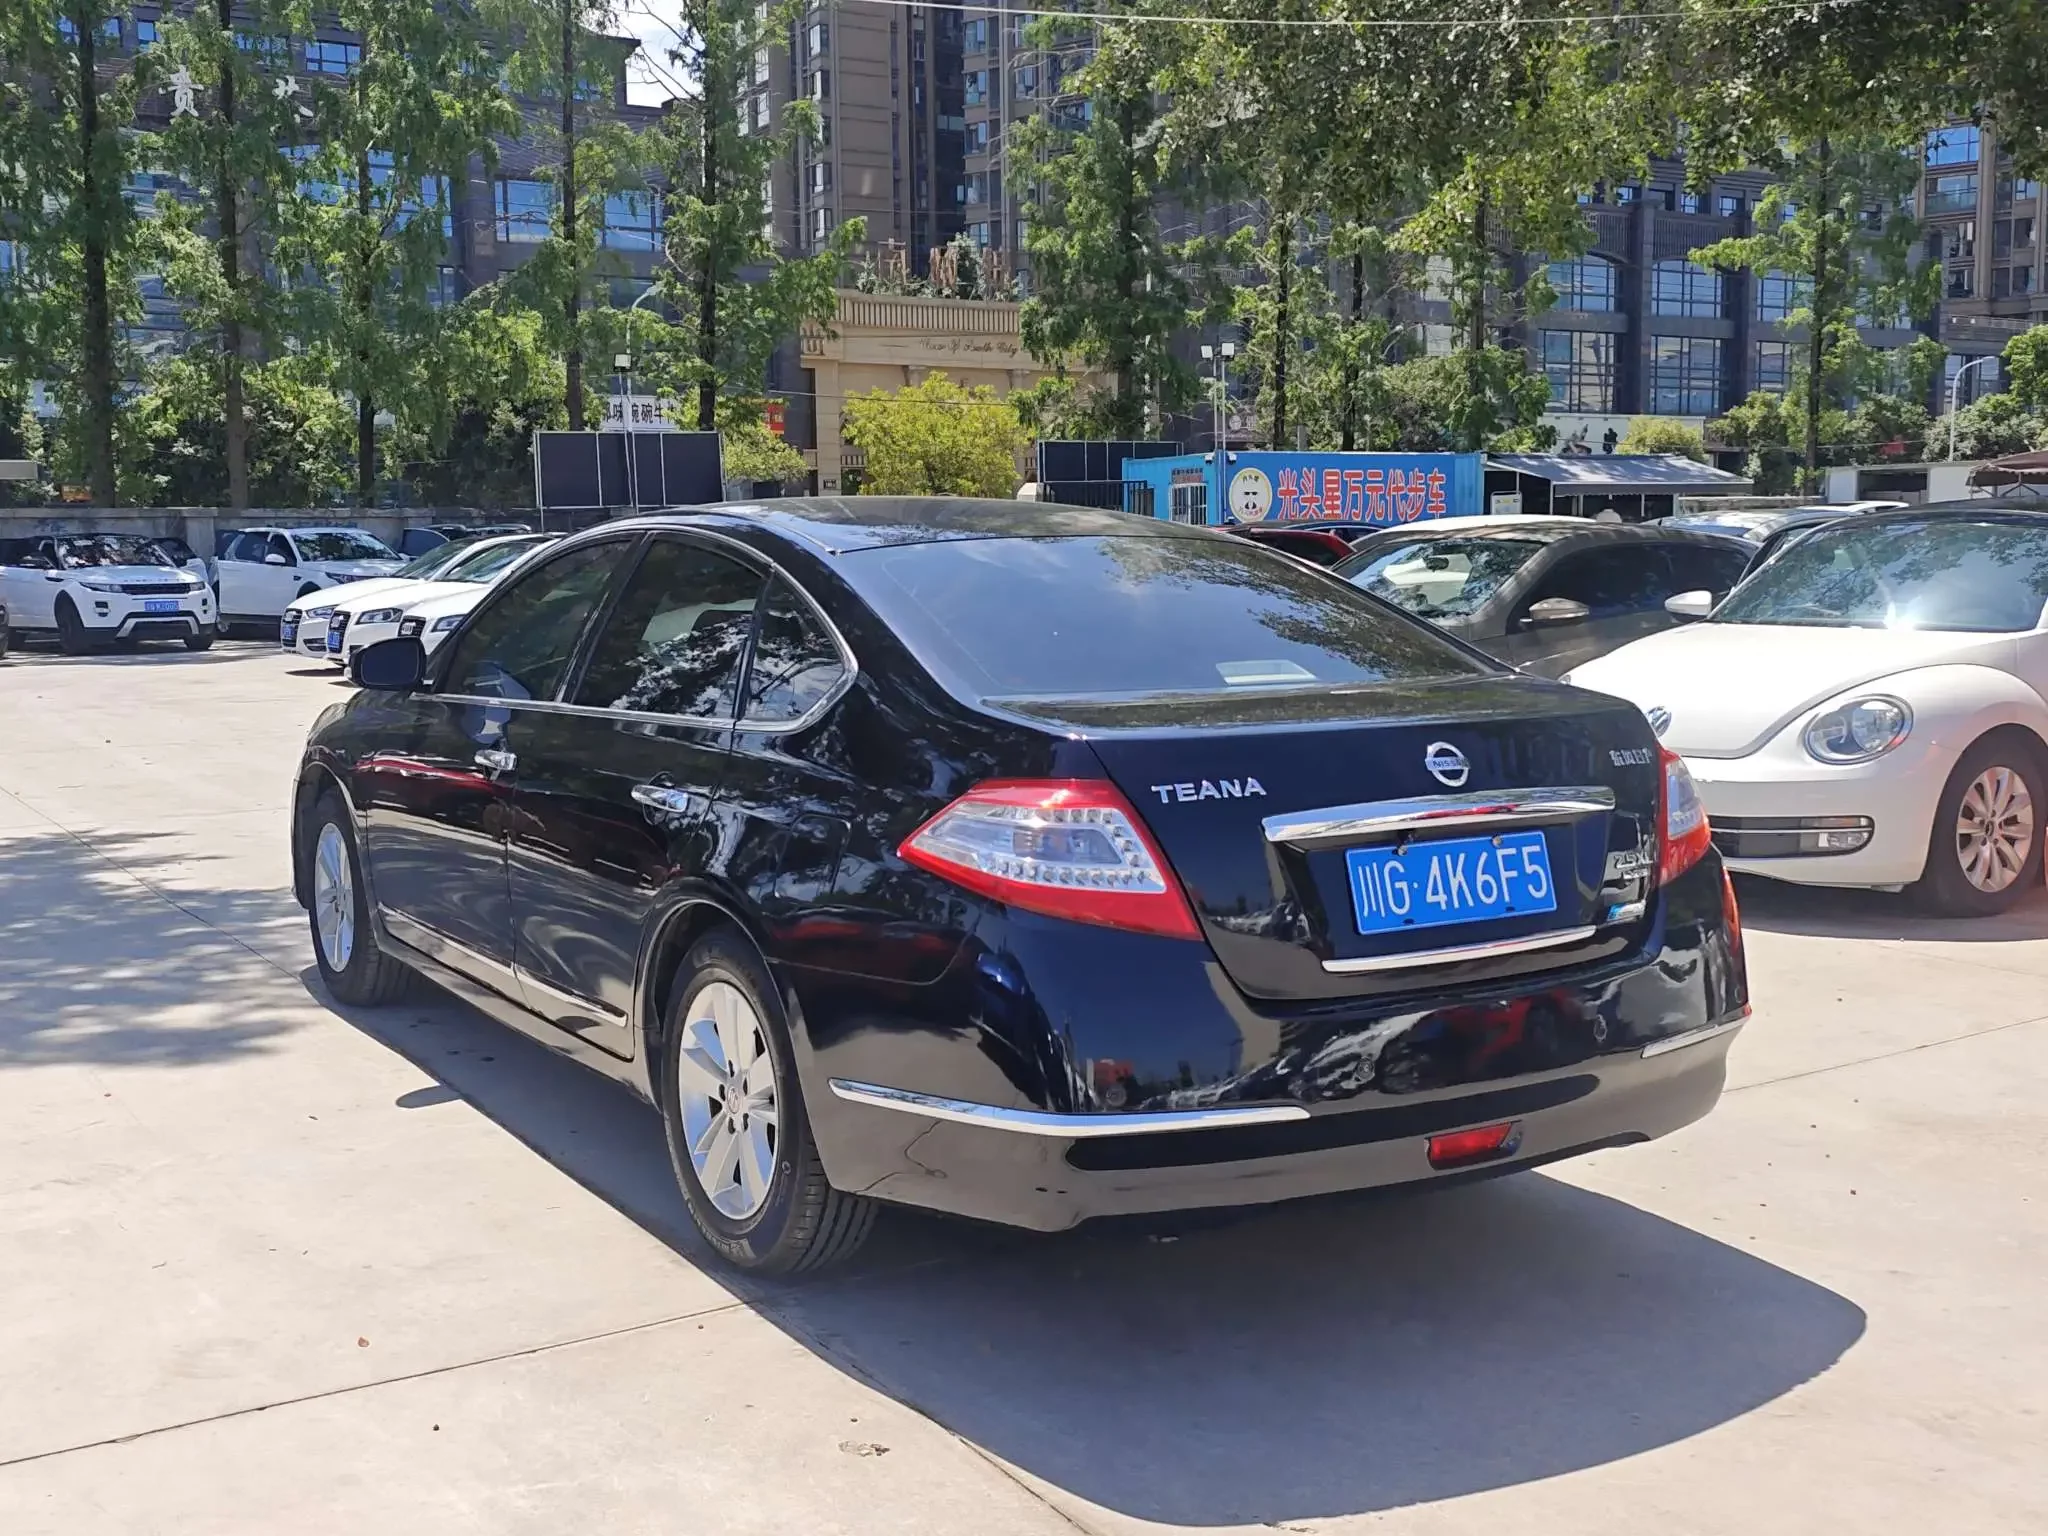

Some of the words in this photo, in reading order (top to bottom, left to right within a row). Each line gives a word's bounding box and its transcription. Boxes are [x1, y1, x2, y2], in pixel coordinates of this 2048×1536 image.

[1277, 467, 1447, 521] 光头星万元代步车
[1150, 776, 1268, 804] TEANA
[1358, 844, 1548, 919] 川G·4K6F5
